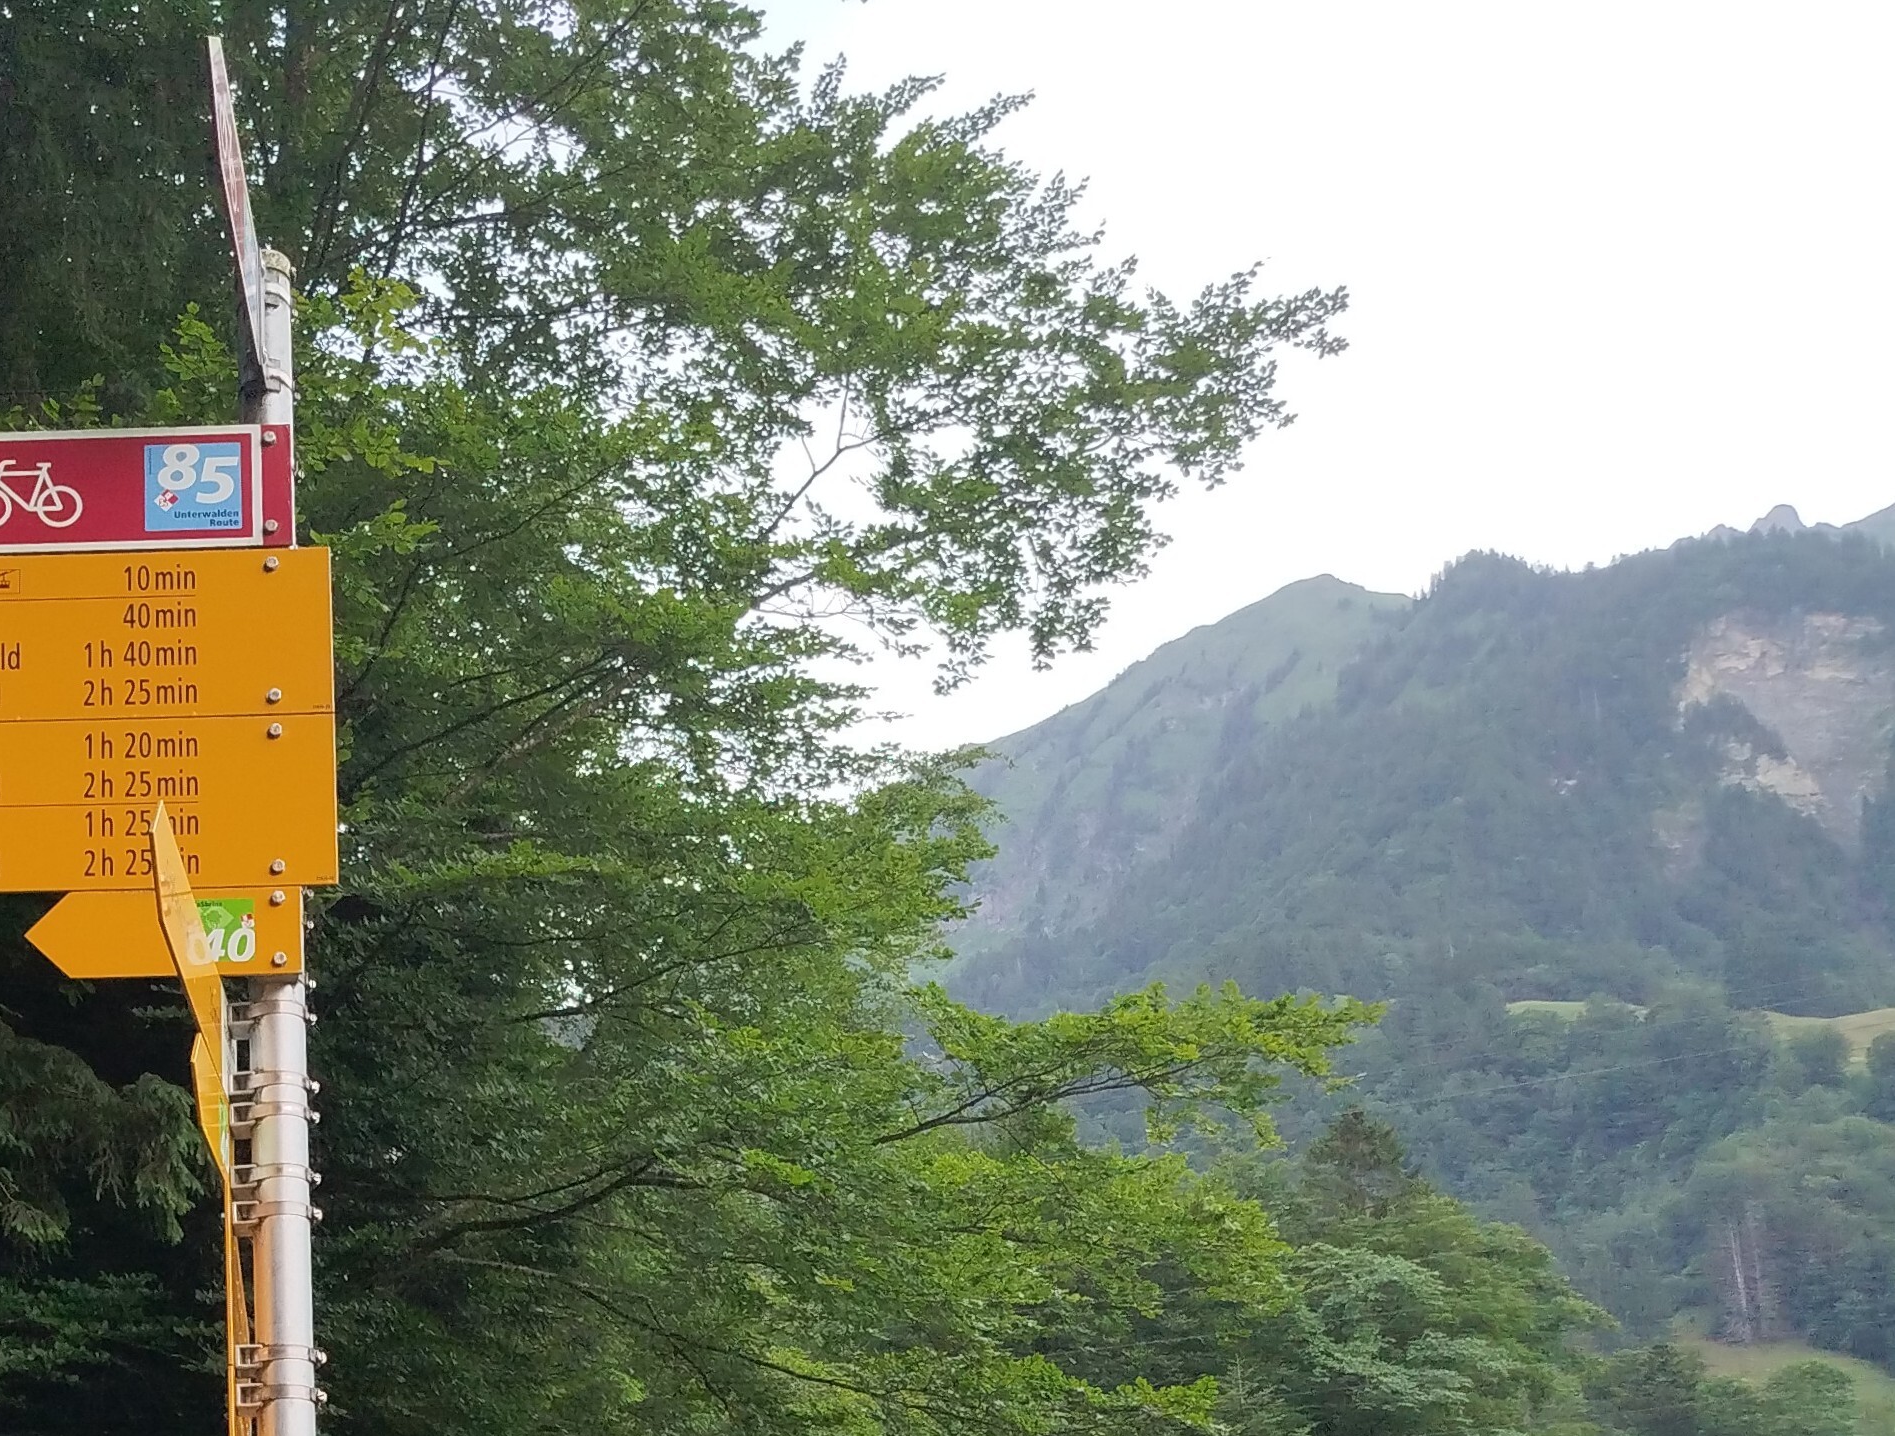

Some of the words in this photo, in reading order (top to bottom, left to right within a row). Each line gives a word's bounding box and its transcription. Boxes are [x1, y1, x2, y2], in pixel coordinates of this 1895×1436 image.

[157, 443, 239, 504] 85
[173, 509, 239, 519] Unterwalden
[209, 518, 239, 527] Route
